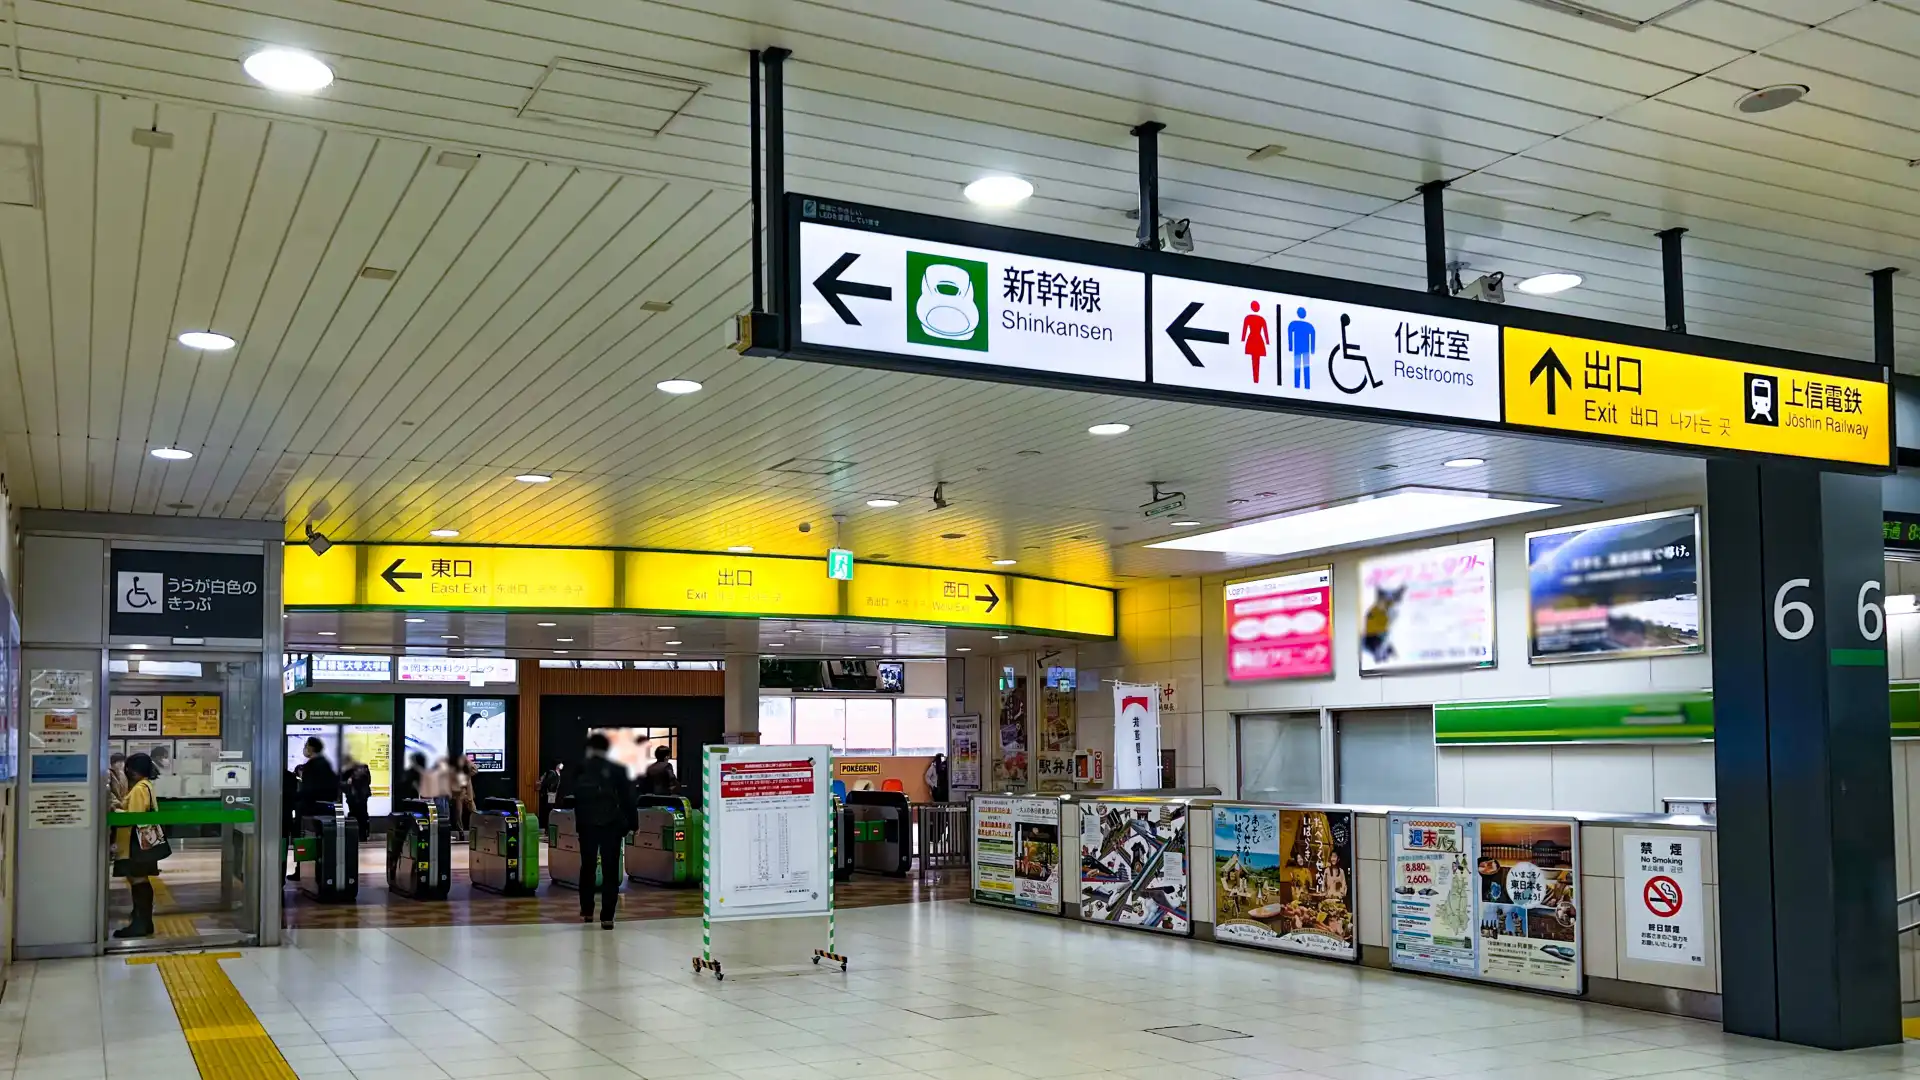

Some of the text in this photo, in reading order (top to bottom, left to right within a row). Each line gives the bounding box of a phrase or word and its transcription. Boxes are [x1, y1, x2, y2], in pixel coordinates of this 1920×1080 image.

[1003, 265, 1102, 313] 新幹線
[1002, 310, 1113, 342] Shinkansen
[1395, 321, 1471, 362] 化粧室
[1394, 360, 1474, 387] Restrooms
[1584, 350, 1642, 395] 出口
[1785, 379, 1863, 415] 上信電鉄
[1585, 401, 1731, 437] Exit 出口 나가는 곳
[1826, 417, 1869, 439] Railway
[430, 558, 473, 578] 東口
[718, 568, 752, 586] 出口
[168, 577, 257, 595] うらが白色の
[431, 583, 459, 594] East
[463, 583, 487, 594] Exit
[687, 589, 708, 600] Exit
[943, 581, 970, 598] 西口
[168, 596, 212, 612] きっぷ
[1774, 578, 1814, 640] 6
[1858, 580, 1884, 641] 6
[1163, 683, 1174, 701] 中
[1409, 828, 1458, 852] 週末パス
[1652, 857, 1683, 866] Smoking
[1511, 880, 1542, 891] 東日本を
